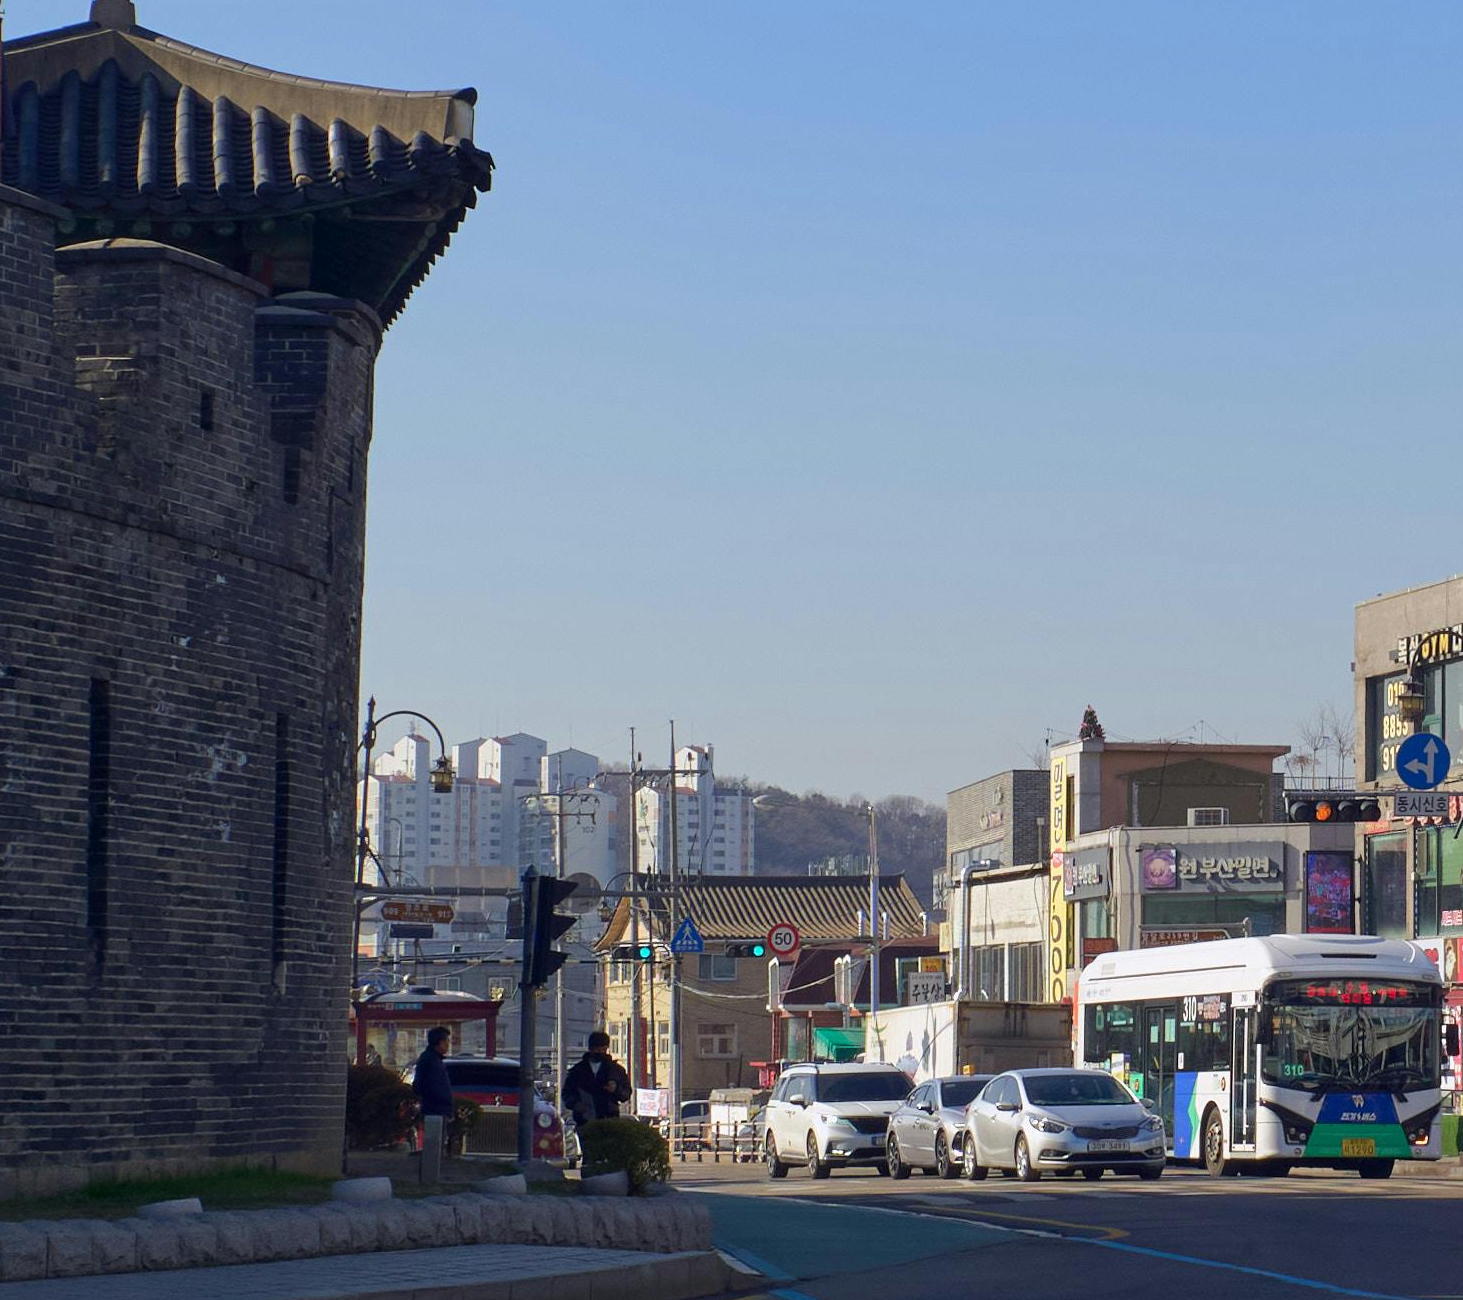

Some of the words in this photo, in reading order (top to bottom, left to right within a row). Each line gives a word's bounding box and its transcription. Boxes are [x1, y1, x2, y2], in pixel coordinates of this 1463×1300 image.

[1421, 633, 1449, 659] GYM
[1397, 796, 1449, 814] 동시신호
[1179, 857, 1197, 879] 원
[774, 932, 792, 946] 50
[1182, 996, 1197, 1022] 310
[1284, 1065, 1304, 1077] 310
